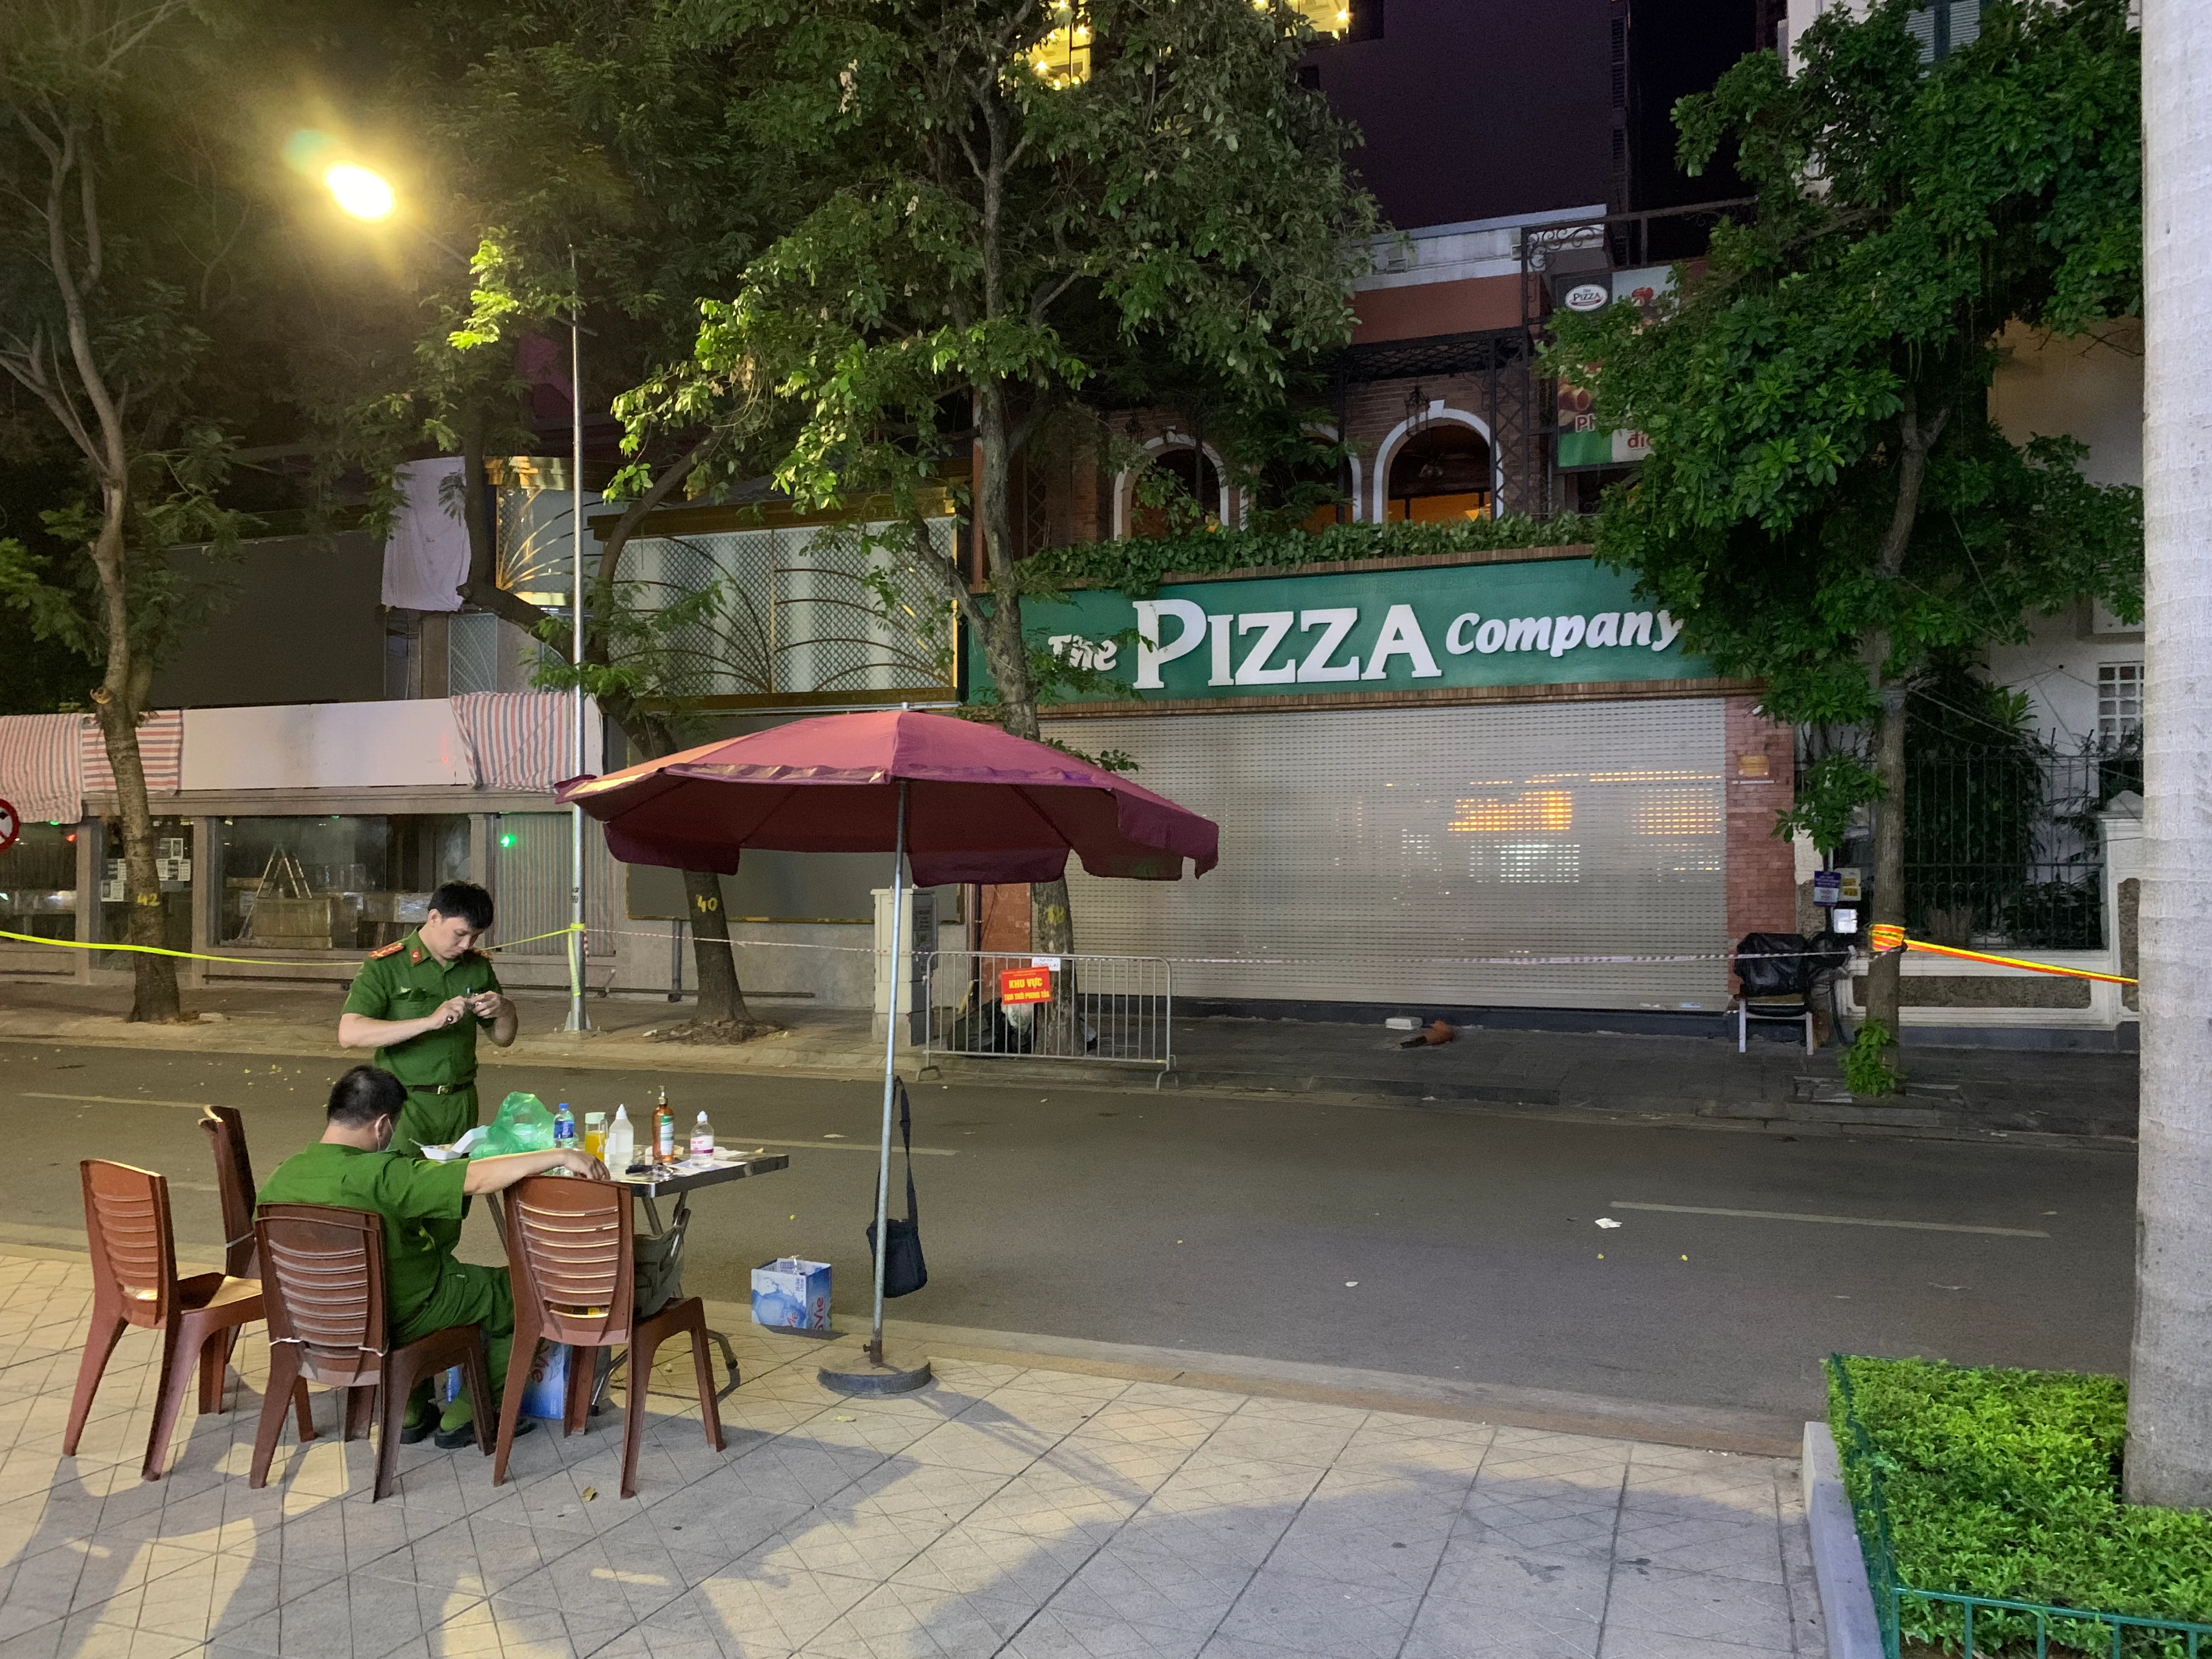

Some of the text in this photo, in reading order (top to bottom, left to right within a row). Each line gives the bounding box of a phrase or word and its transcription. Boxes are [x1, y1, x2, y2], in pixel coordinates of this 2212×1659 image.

[1573, 292, 1601, 302] PIZZA
[1048, 599, 1685, 690] The PIZZA Company
[137, 892, 160, 906] 42
[696, 894, 718, 913] 40
[1008, 977, 1043, 989] KHU VỰC
